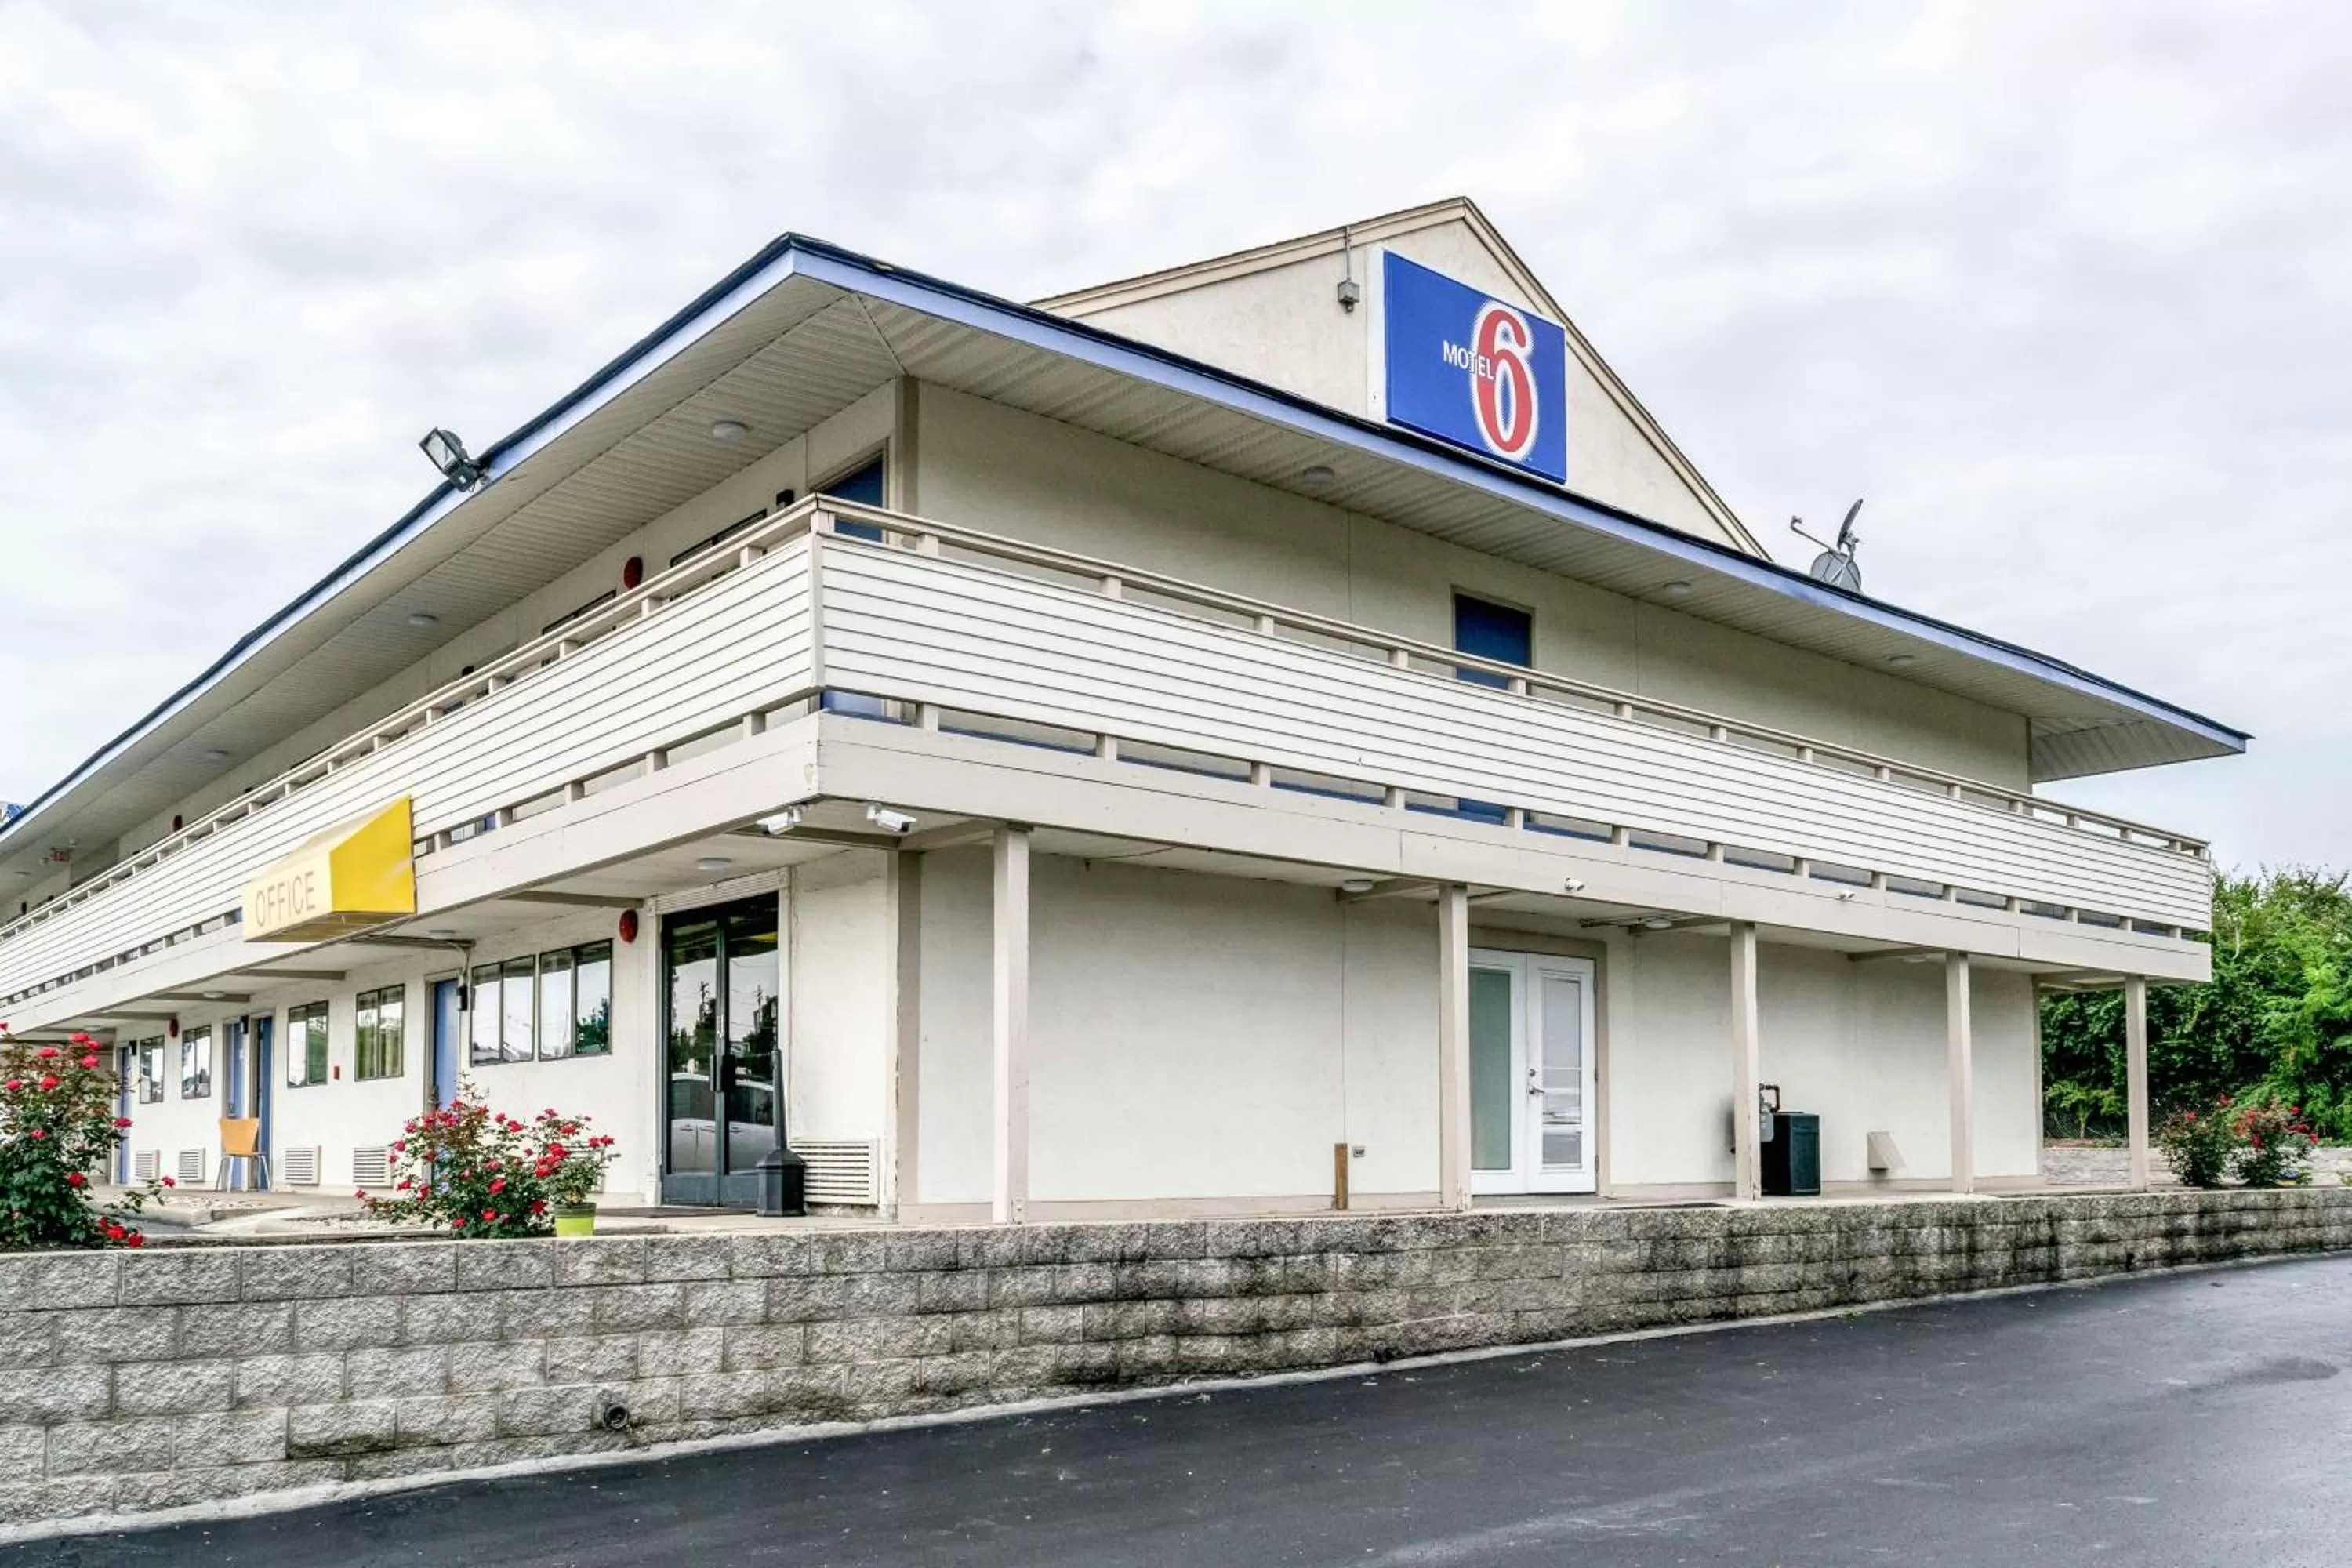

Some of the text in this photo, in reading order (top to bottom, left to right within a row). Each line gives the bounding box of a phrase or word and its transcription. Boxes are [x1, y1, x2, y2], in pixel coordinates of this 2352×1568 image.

[1443, 307, 1534, 455] MOTEL 6
[255, 871, 316, 927] OFFICE
